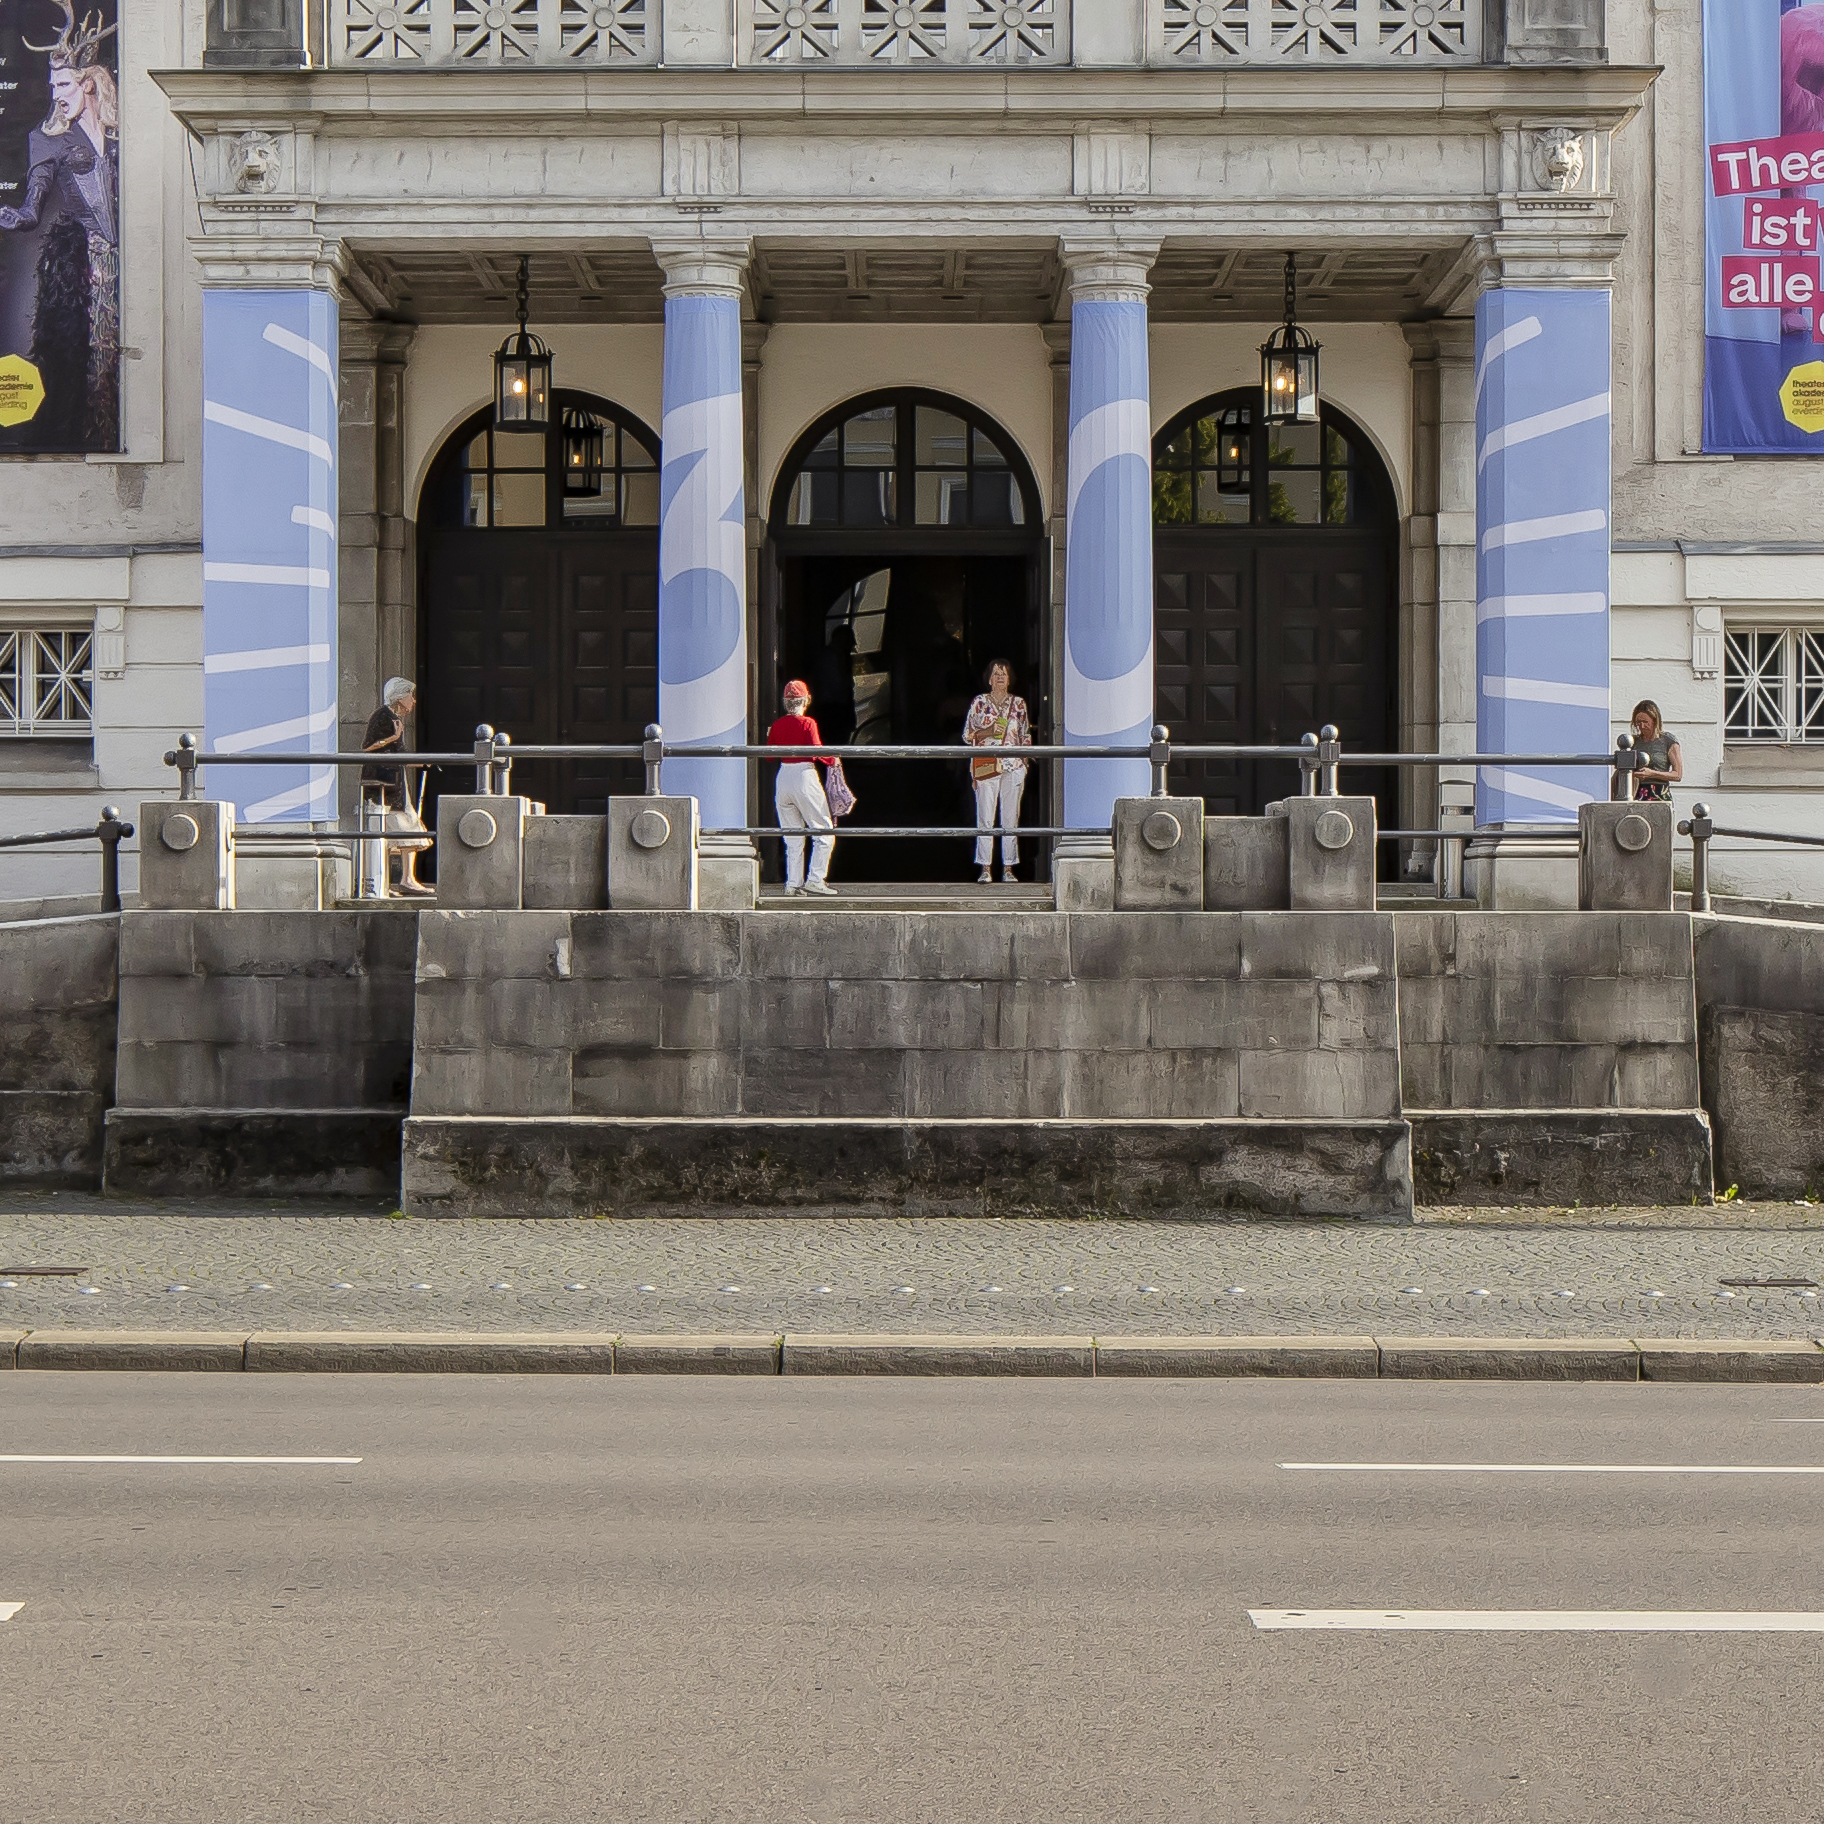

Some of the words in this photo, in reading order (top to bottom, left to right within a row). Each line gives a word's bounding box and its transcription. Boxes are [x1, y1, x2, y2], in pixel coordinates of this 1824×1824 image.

[1751, 203, 1812, 246] ist
[1728, 262, 1814, 303] alle
[1792, 379, 1824, 388] theater
[1792, 397, 1824, 407] august
